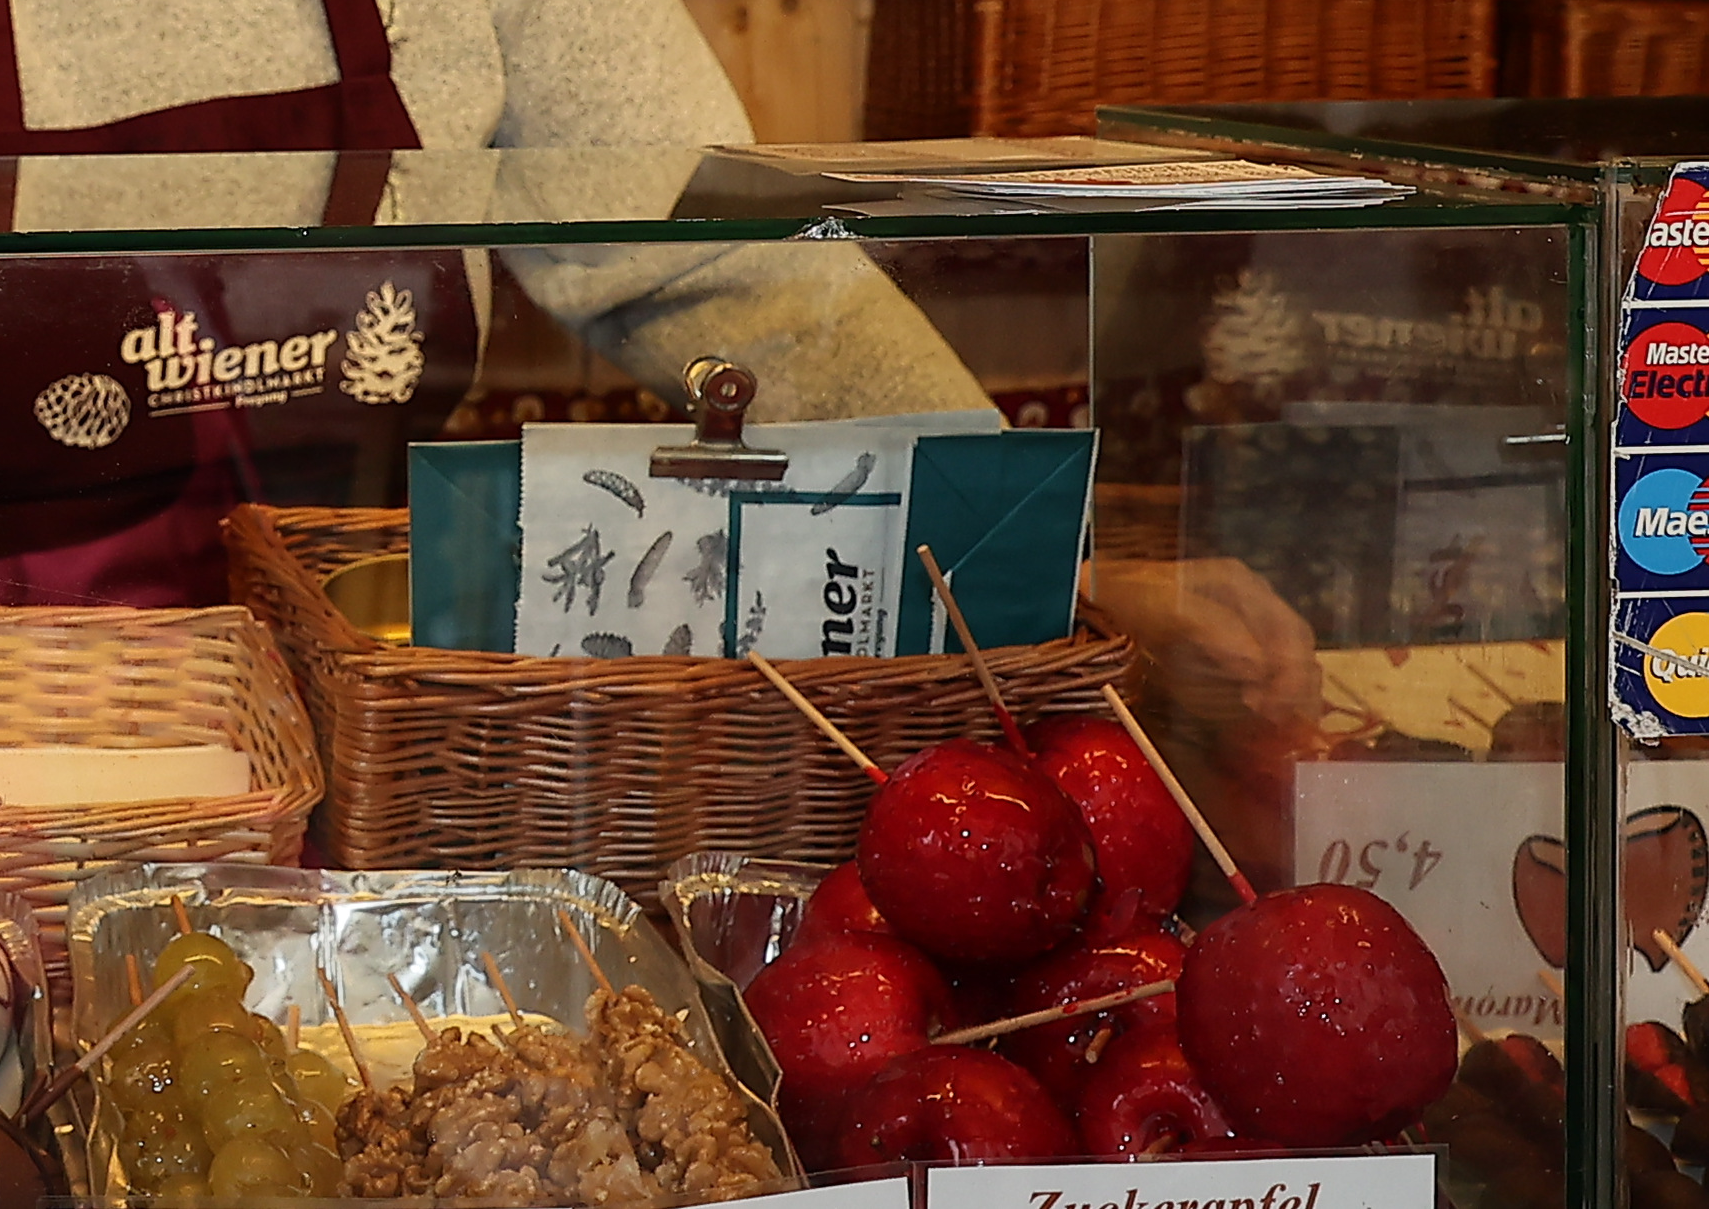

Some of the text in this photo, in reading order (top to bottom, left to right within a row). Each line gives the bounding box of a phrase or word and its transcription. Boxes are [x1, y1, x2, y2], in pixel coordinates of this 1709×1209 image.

[120, 310, 199, 364] alt
[1630, 369, 1709, 398] Elect
[1634, 506, 1709, 537] Mae
[1317, 829, 1443, 889] 4,50
